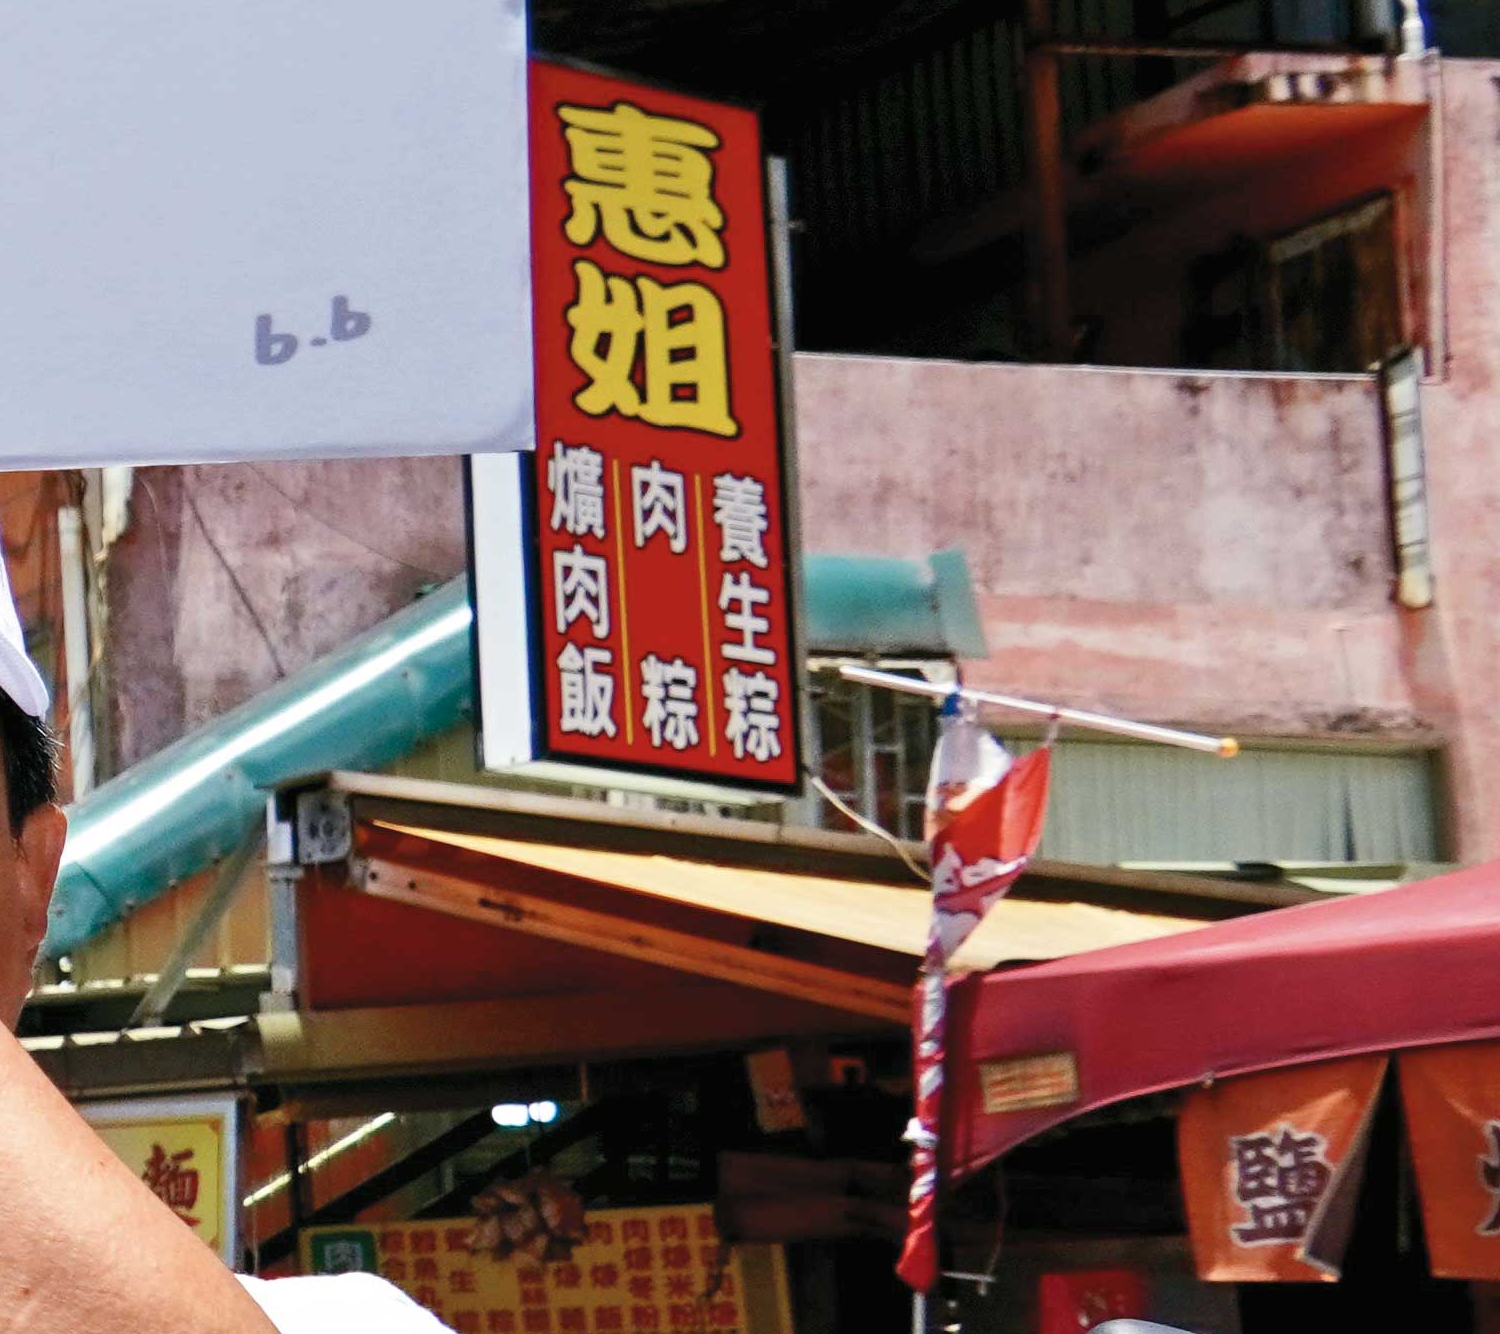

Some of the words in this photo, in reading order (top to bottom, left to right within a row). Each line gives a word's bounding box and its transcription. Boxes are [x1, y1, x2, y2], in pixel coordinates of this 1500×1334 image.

[557, 102, 740, 438] 惠姐
[712, 473, 781, 762] 養生粽
